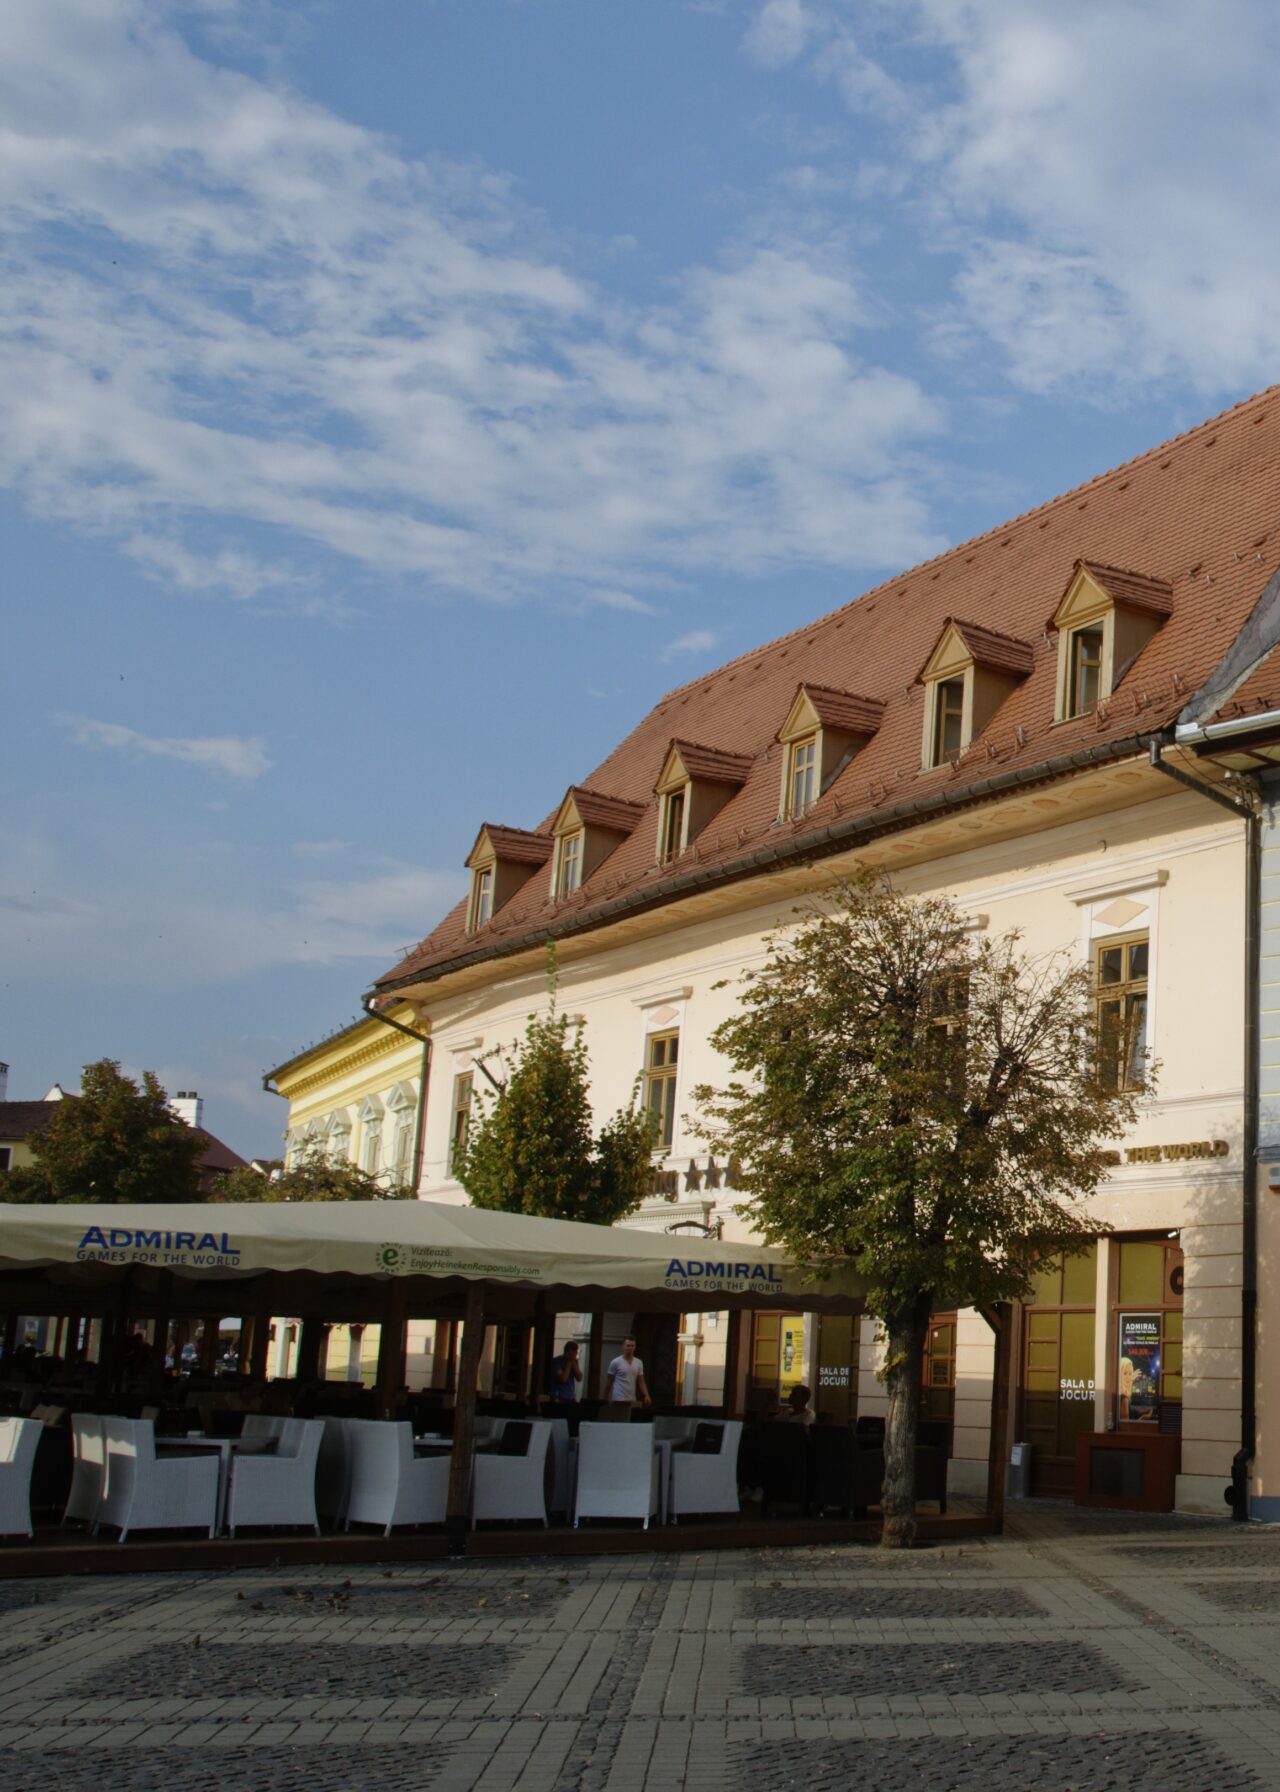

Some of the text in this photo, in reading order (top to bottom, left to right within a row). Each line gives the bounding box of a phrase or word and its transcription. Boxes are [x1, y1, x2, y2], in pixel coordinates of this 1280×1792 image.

[1124, 1146, 1161, 1164] THE
[1162, 1140, 1230, 1161] WORLD
[78, 1226, 240, 1255] ADMIRAL
[76, 1250, 241, 1266] GAMES FOR THE WORLD
[666, 1259, 783, 1283] ADMIRAL
[664, 1279, 784, 1293] GAMES FOR THE WORLD
[820, 1368, 838, 1376] SALA
[1060, 1379, 1095, 1389] SALA D
[1060, 1389, 1096, 1401] JOCUR
